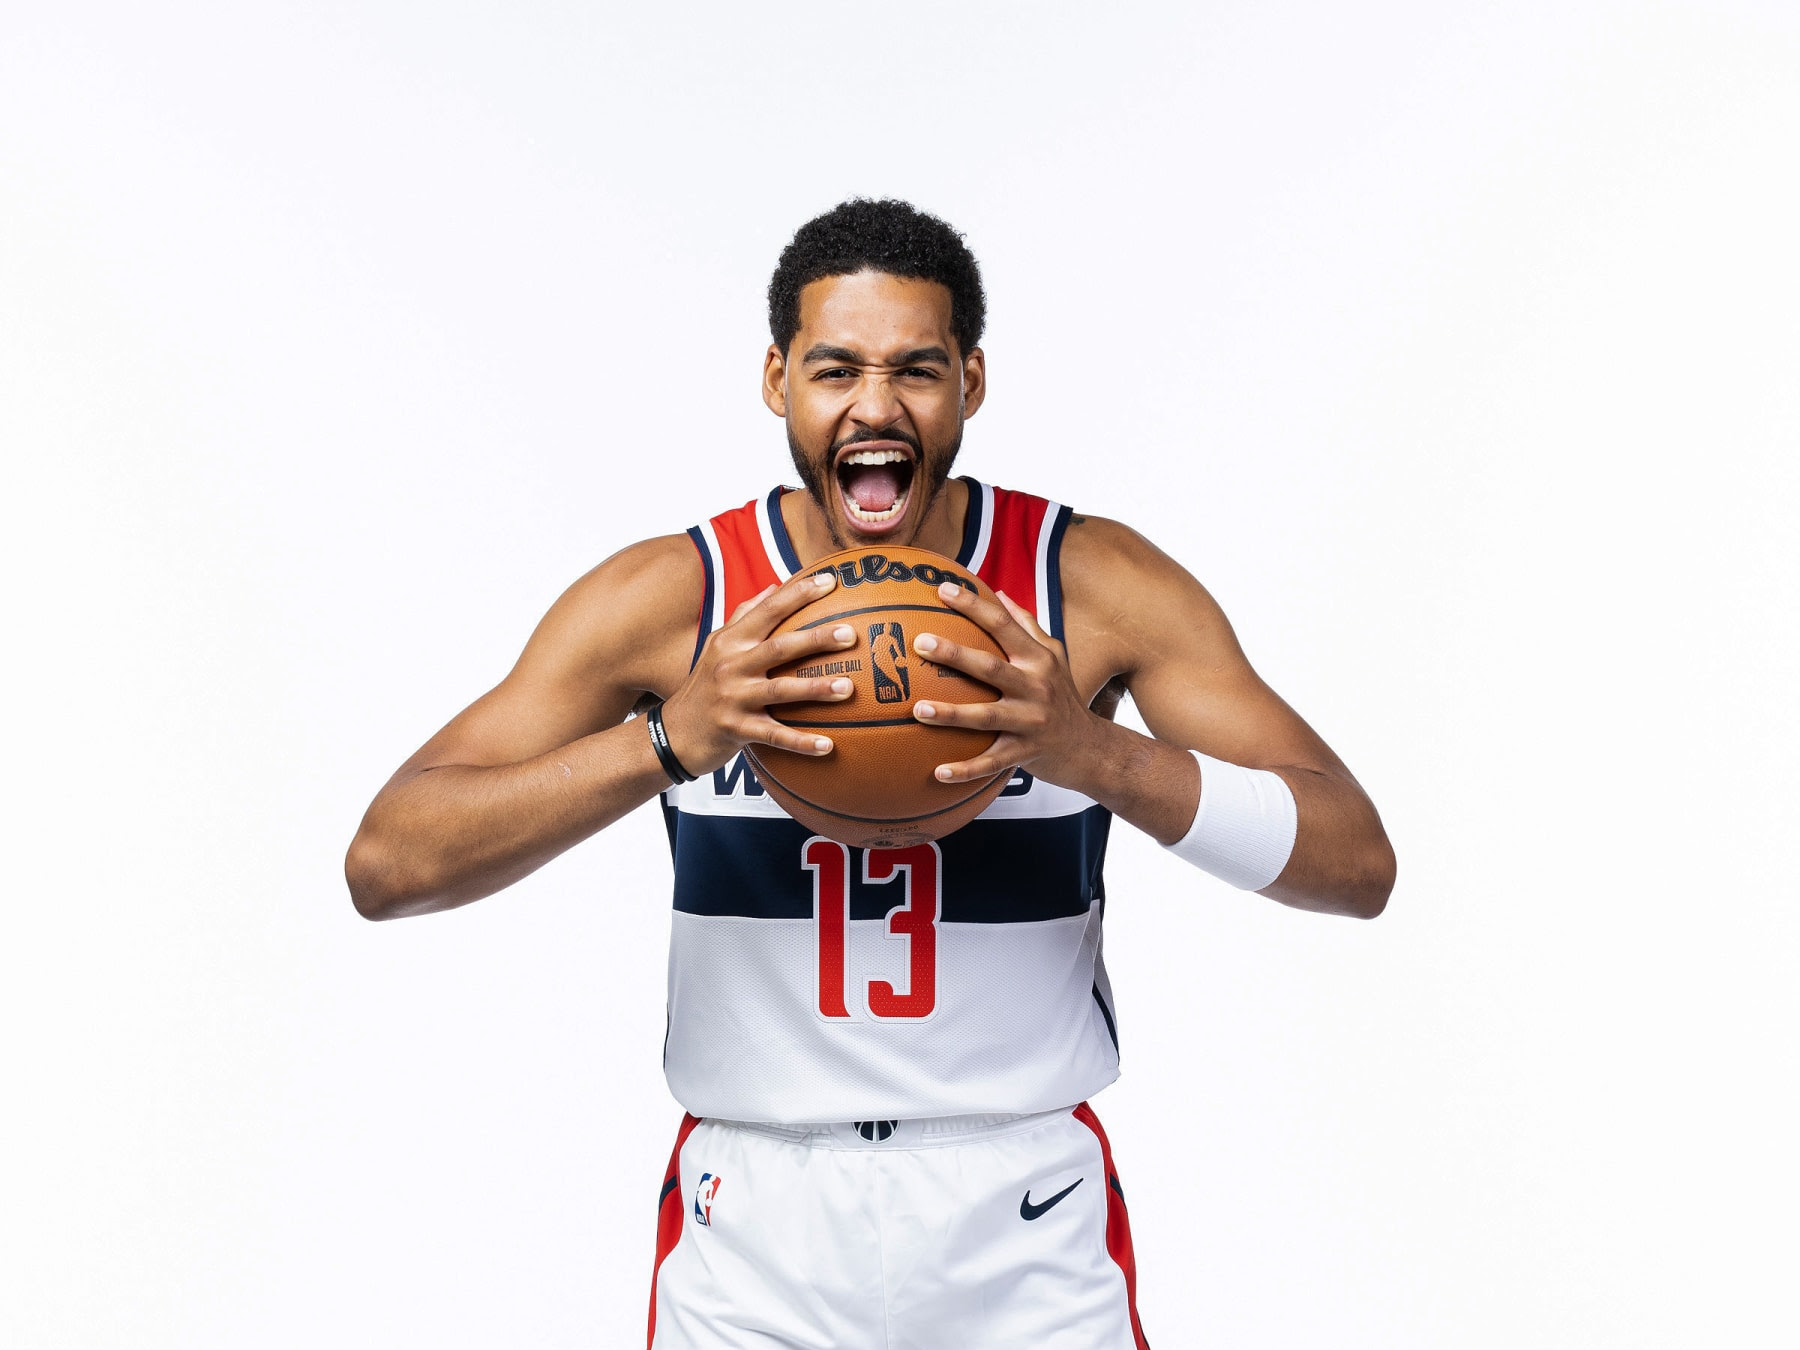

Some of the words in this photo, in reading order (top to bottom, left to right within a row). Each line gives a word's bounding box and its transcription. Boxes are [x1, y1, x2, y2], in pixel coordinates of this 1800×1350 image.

[825, 662, 845, 675] GAME
[845, 659, 863, 673] BALL
[878, 686, 898, 700] NBA
[802, 836, 942, 1023] 13
